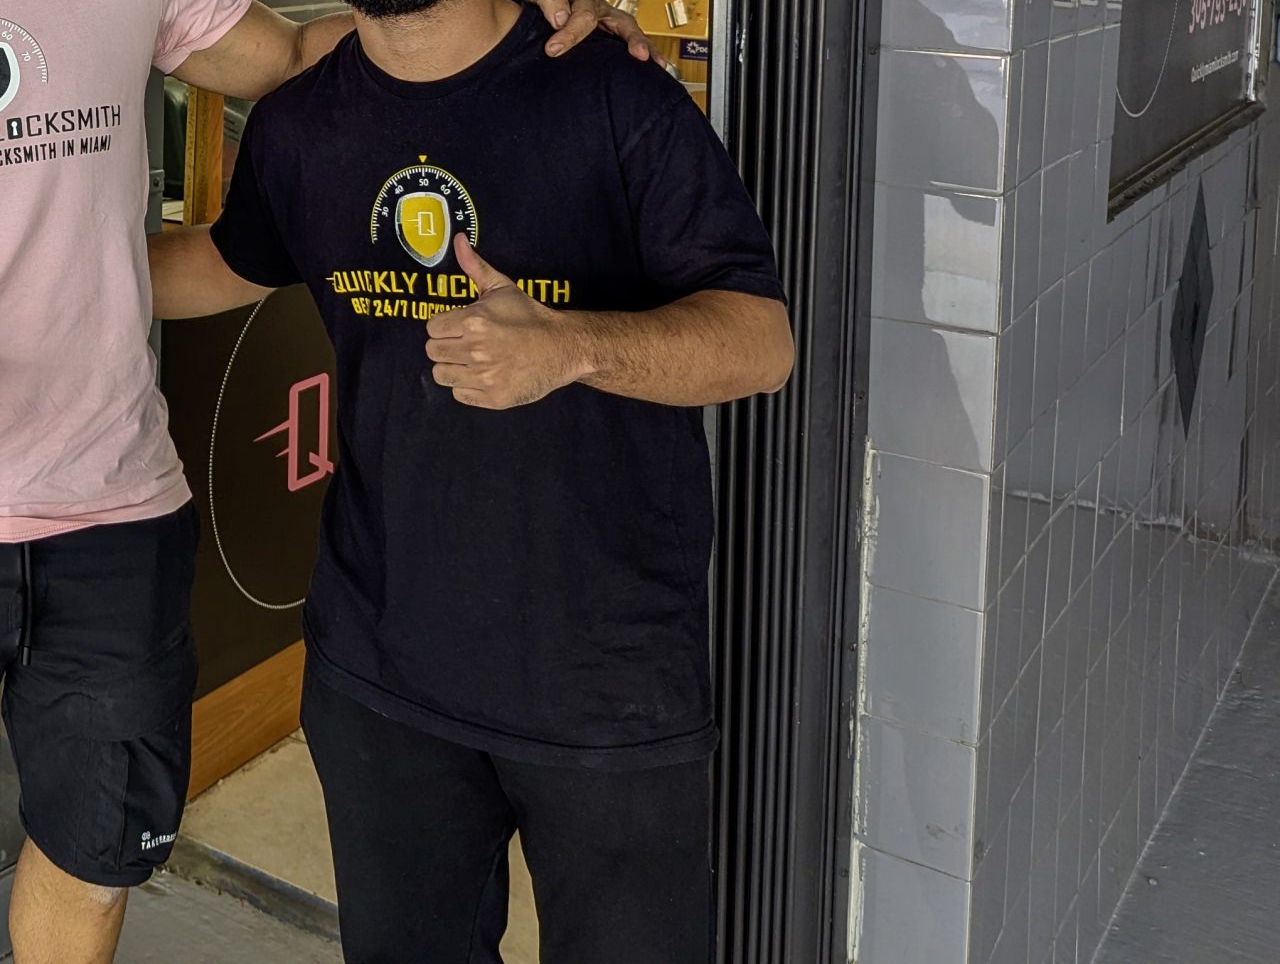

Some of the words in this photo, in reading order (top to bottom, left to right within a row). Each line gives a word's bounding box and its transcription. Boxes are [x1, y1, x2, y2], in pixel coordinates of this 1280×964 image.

[1, 30, 13, 41] 60
[21, 51, 32, 62] 70
[62, 141, 75, 156] IN
[80, 134, 111, 154] MIAMI
[382, 206, 389, 217] 30
[394, 185, 404, 195] 40
[418, 178, 429, 186] 50
[440, 184, 451, 195] 60
[455, 209, 464, 221] 70
[330, 271, 418, 294] QUICKLY
[373, 299, 408, 317] 24/7
